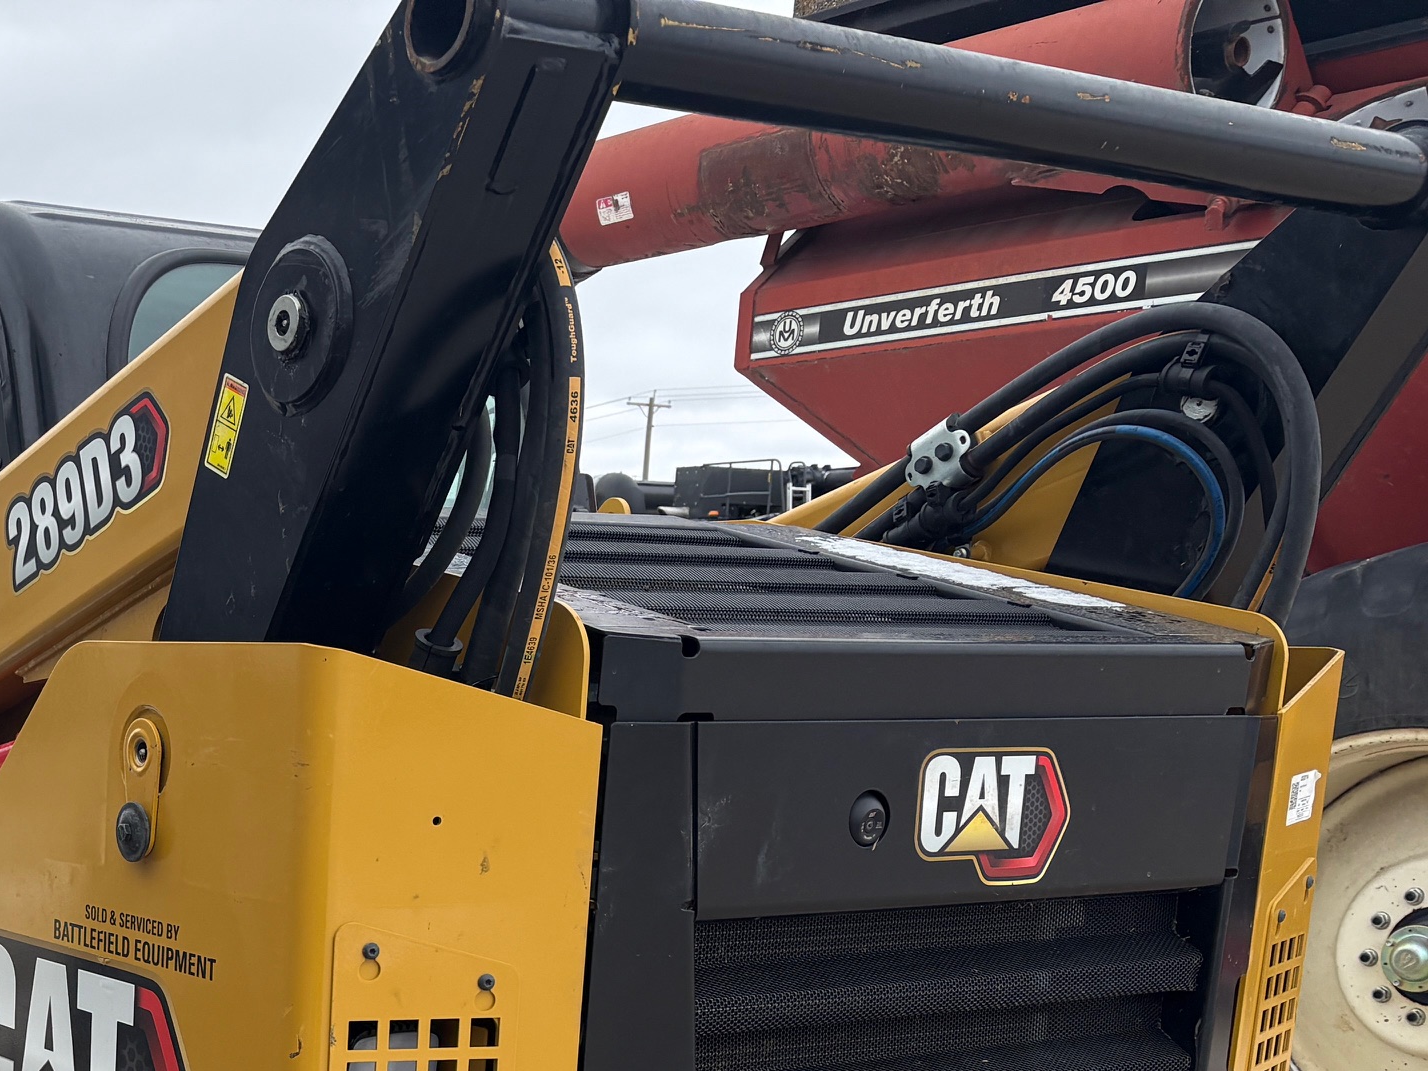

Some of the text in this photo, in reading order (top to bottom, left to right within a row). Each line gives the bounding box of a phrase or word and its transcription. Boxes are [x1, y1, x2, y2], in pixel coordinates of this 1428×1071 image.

[842, 269, 1137, 336] Unverferth 4500
[566, 391, 579, 454] CAT 4636
[7, 414, 143, 587] 289D3
[523, 554, 557, 665] 1E4639 MSHA IC-101/36
[920, 754, 1038, 853] CAT
[53, 918, 217, 981] BATTLEFIELD EQUIPMENT
[84, 904, 180, 941] SOLD & SERVICED BY
